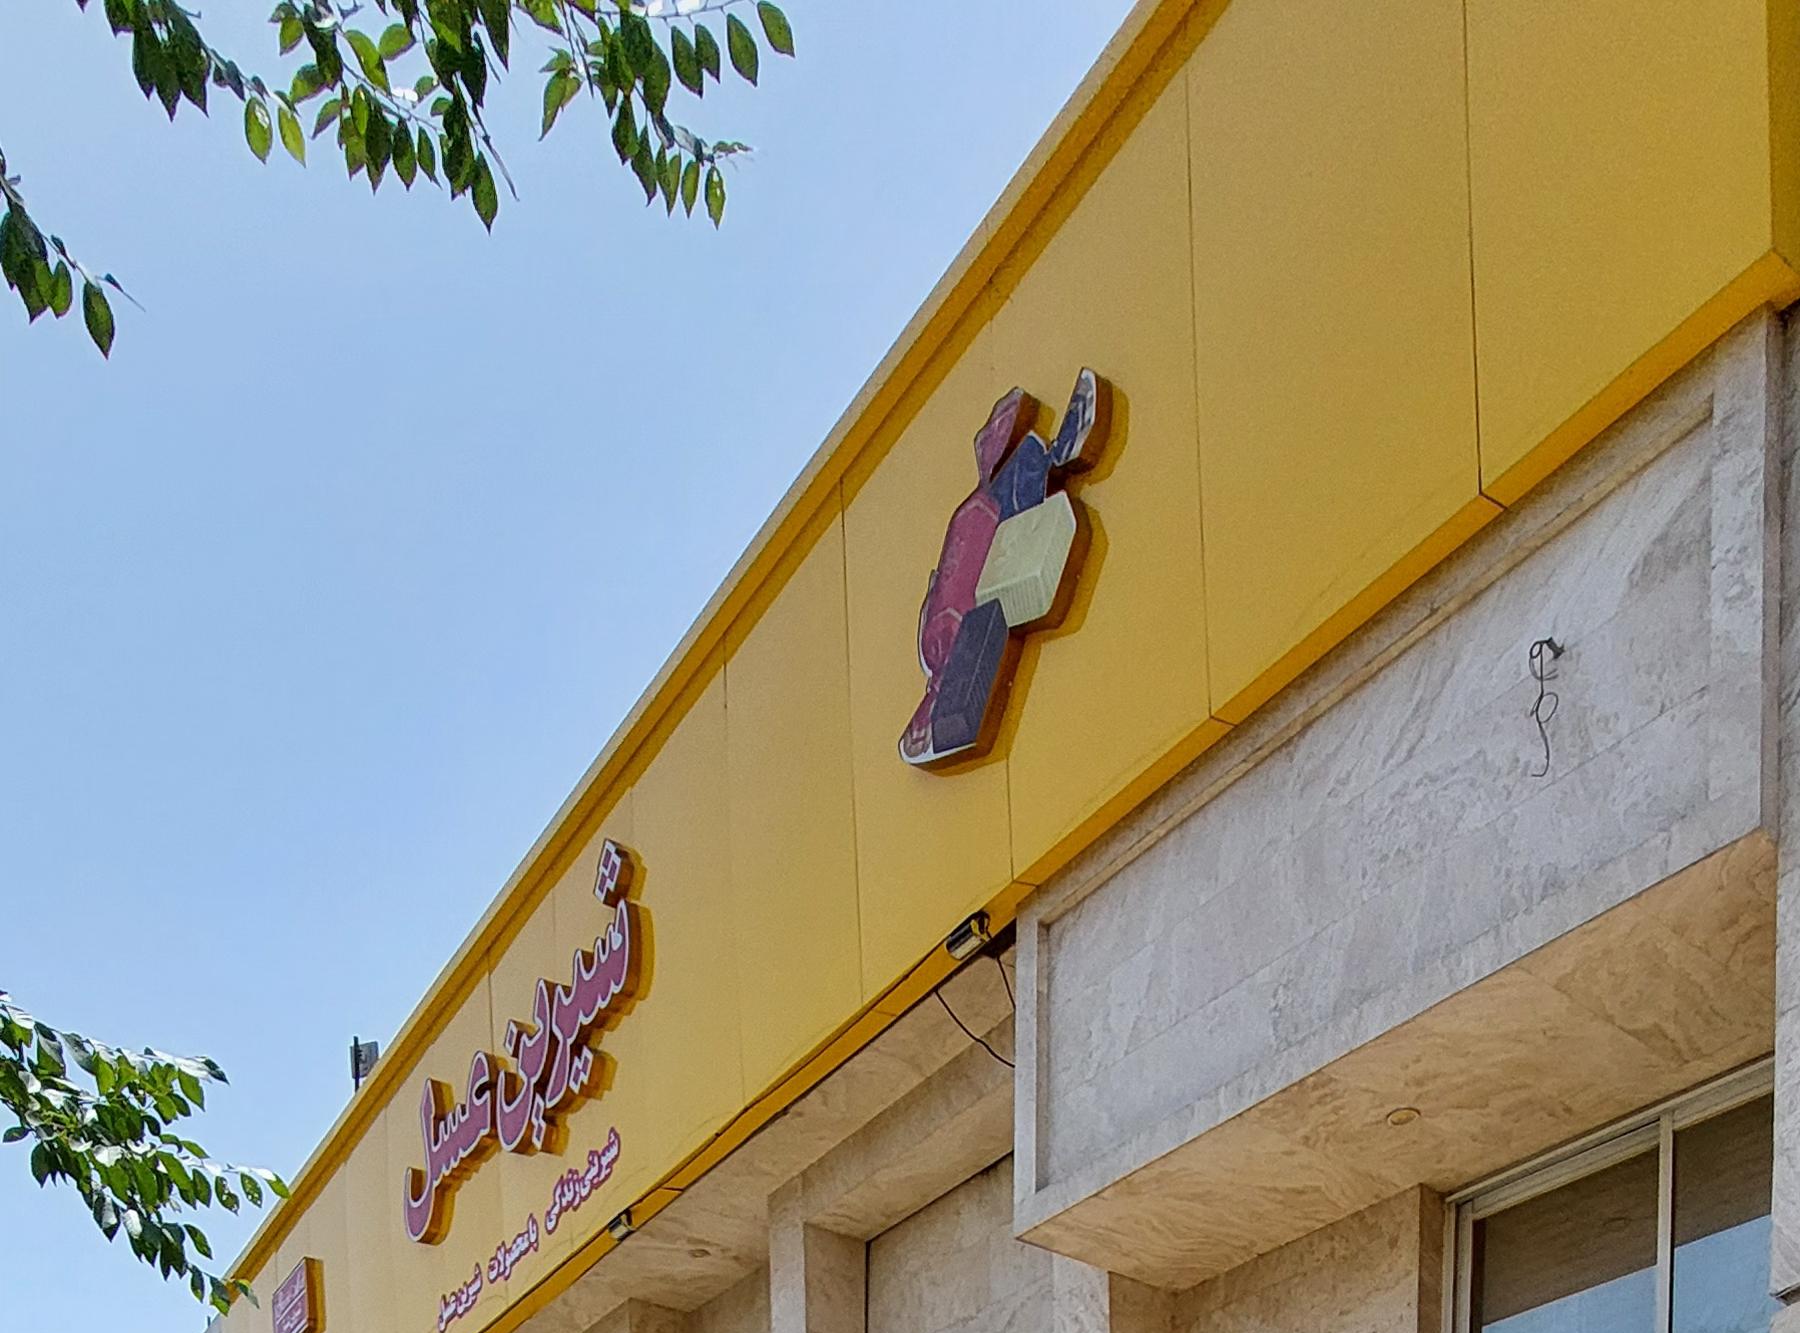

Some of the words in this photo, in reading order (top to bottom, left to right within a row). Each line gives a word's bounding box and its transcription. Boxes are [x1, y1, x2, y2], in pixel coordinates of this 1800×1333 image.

[497, 838, 630, 1152] شیرین
[404, 1050, 492, 1244] عسل
[580, 1127, 621, 1199] شیرینی
[527, 1213, 539, 1251] با
[545, 1169, 581, 1234] زندگی
